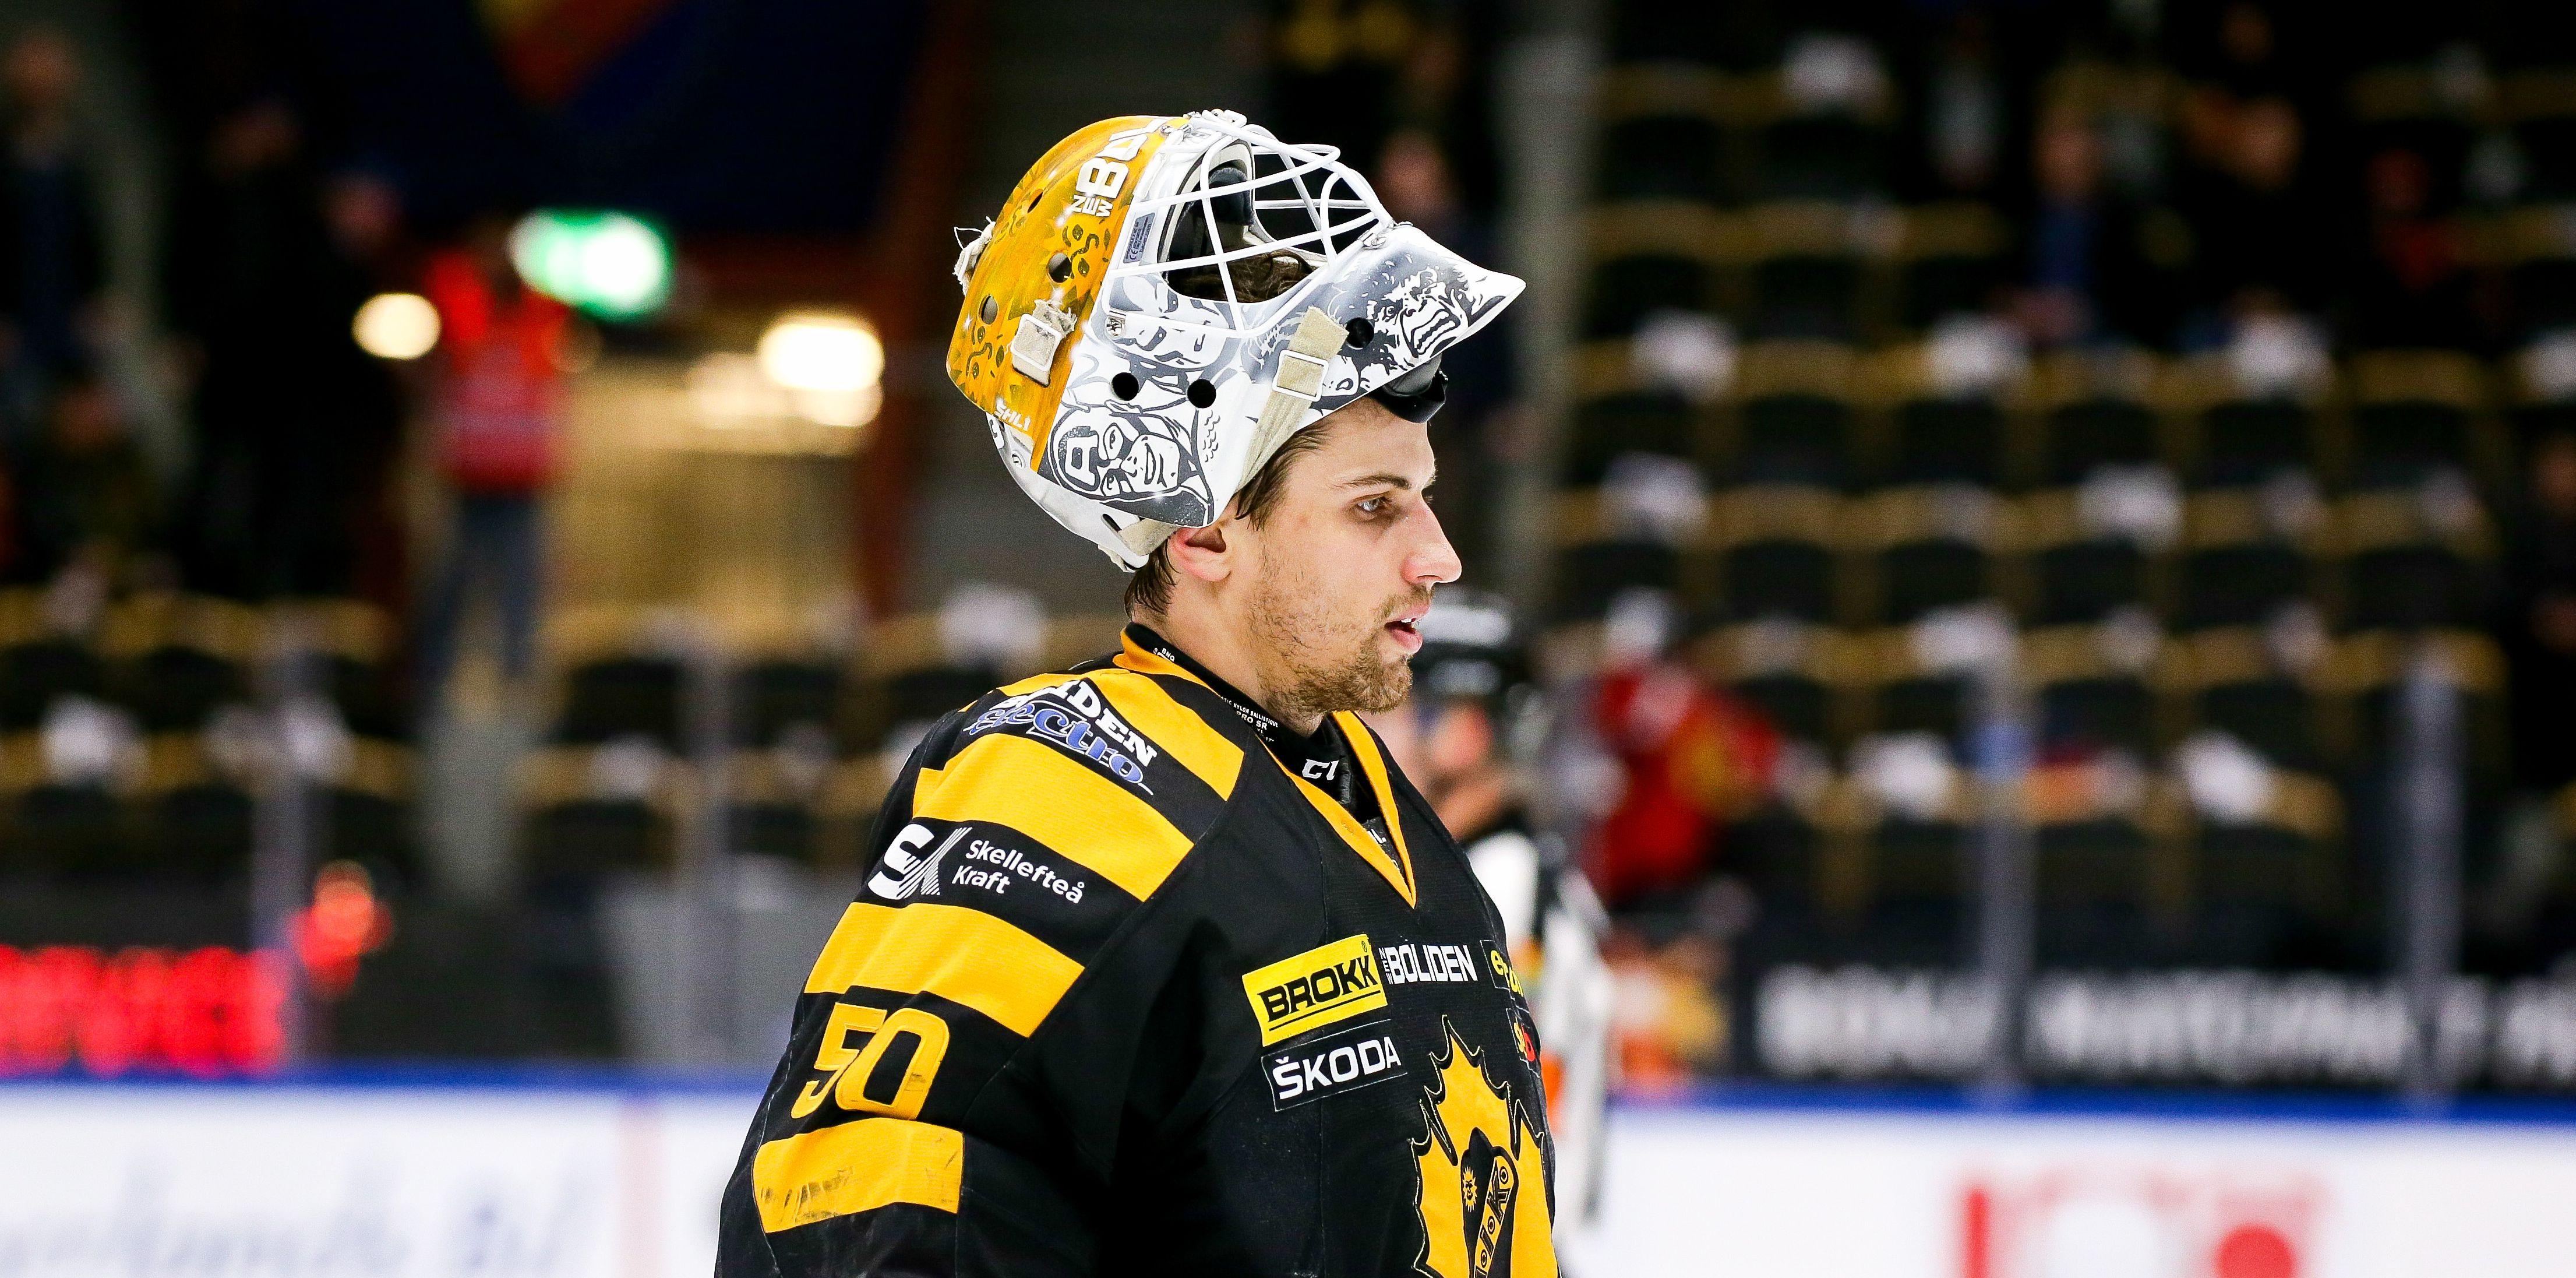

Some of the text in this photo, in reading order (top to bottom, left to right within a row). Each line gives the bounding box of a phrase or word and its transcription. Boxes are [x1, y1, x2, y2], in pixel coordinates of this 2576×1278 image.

[1071, 194, 1113, 217] NEW
[1233, 703, 1250, 714] NYLON
[1236, 710, 1268, 730] PRO SR
[952, 865, 1011, 894] Kraft
[965, 840, 1085, 903] Skellefteå
[1384, 943, 1478, 984] BOLIDEN
[1257, 955, 1378, 1022] BROKK
[791, 1002, 950, 1121] 50
[1272, 1036, 1402, 1100] ŠKODA
